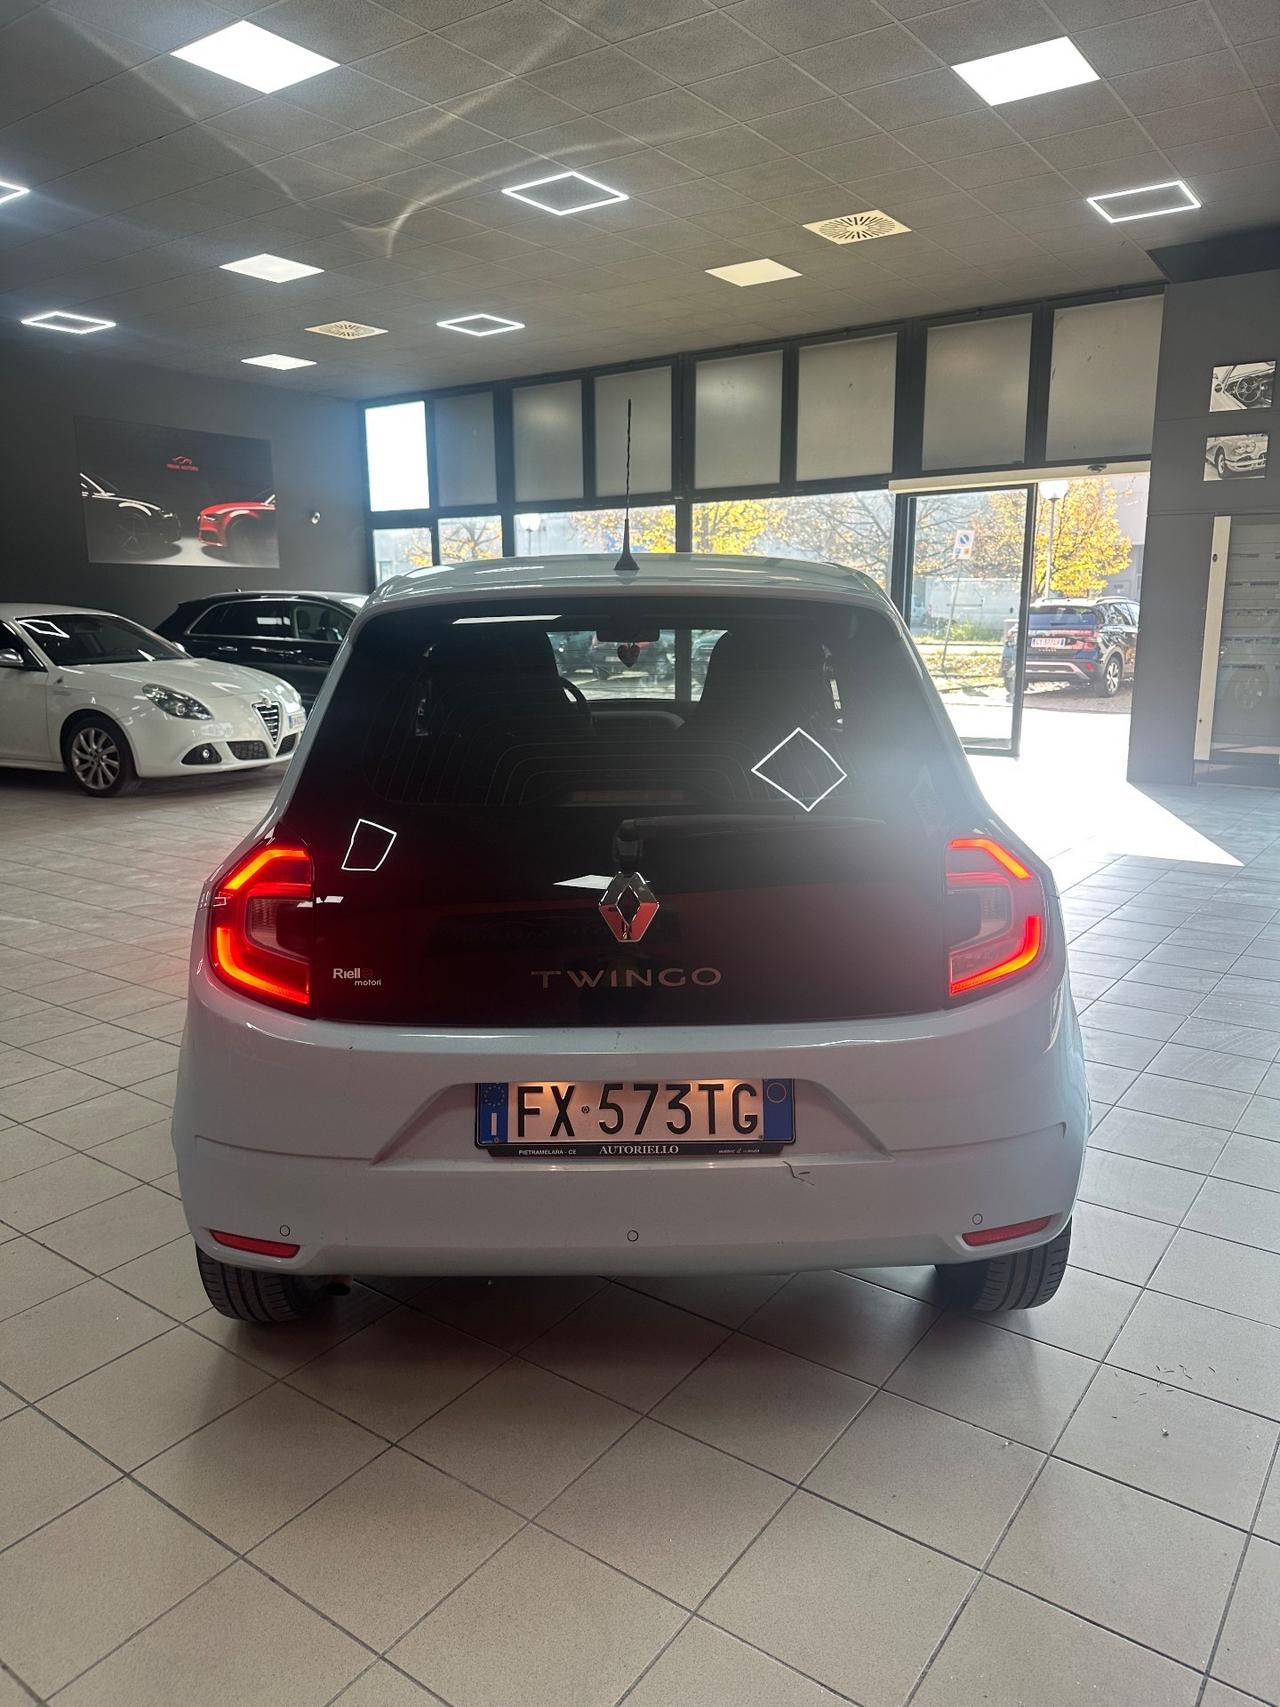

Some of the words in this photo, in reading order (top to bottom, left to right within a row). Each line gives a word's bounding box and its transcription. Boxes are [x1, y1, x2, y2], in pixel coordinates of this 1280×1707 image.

[530, 967, 722, 989] TWINGO
[517, 1085, 576, 1137] FX
[598, 1083, 758, 1135] 573TG
[599, 1144, 680, 1155] AUTORIELLO
